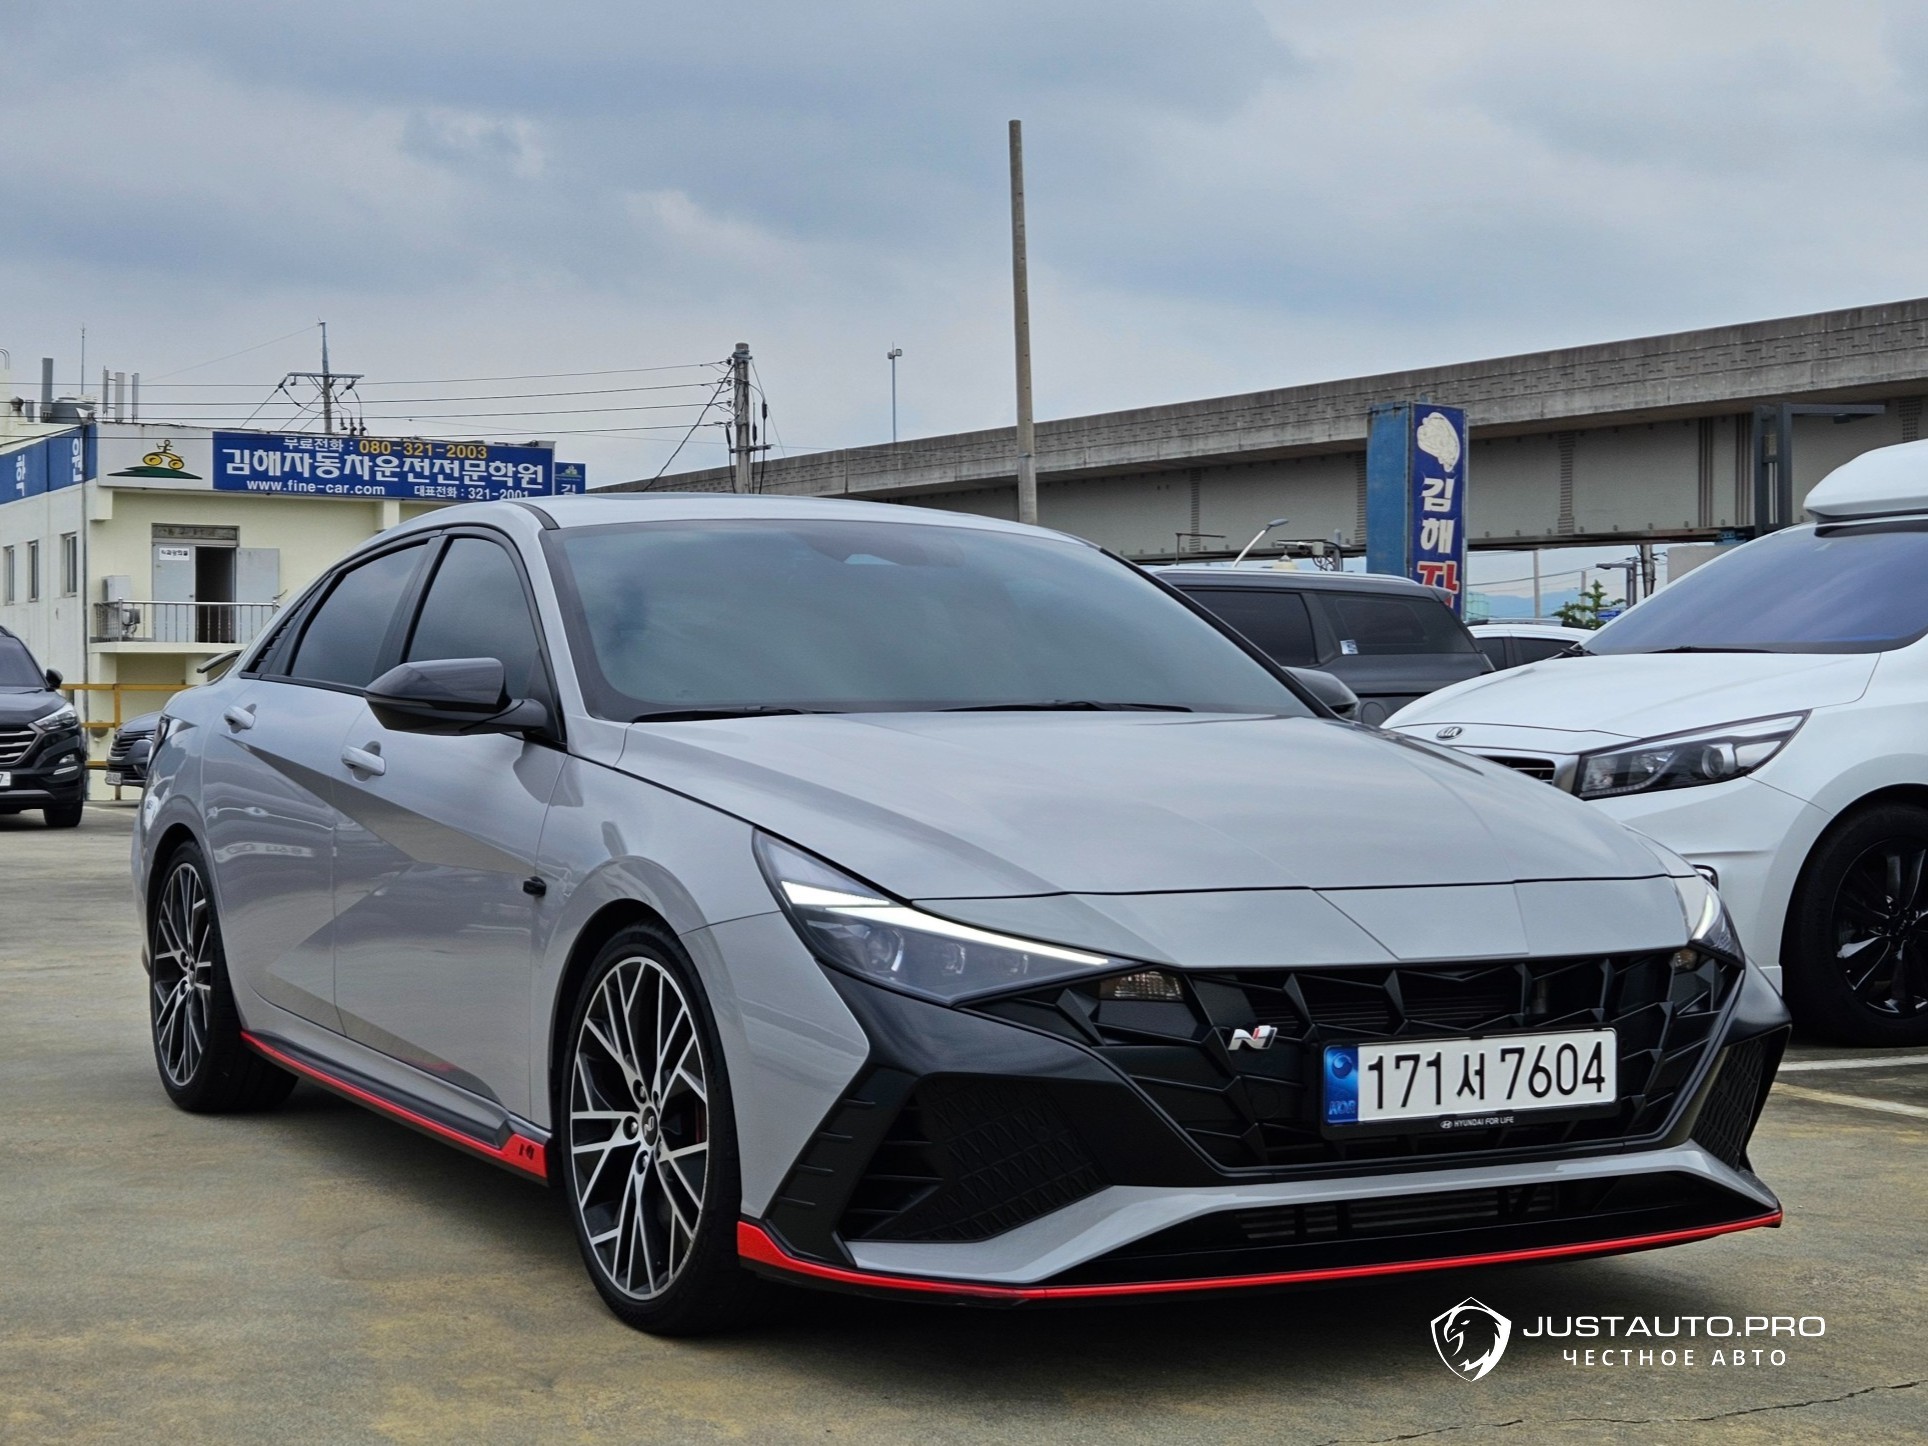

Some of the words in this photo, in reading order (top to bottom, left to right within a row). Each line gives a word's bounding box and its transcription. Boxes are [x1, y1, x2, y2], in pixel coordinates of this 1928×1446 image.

[283, 437, 344, 452] 무료전화
[359, 439, 488, 459] 080-321-2003
[222, 448, 543, 488] 김해자동차운전전문학원
[246, 479, 386, 495] www.fine-car.com
[414, 485, 458, 499] 대표전화
[1454, 1117, 1485, 1127] HYUNDAI
[1485, 1116, 1499, 1125] FOR
[1500, 1116, 1515, 1124] LIFE
